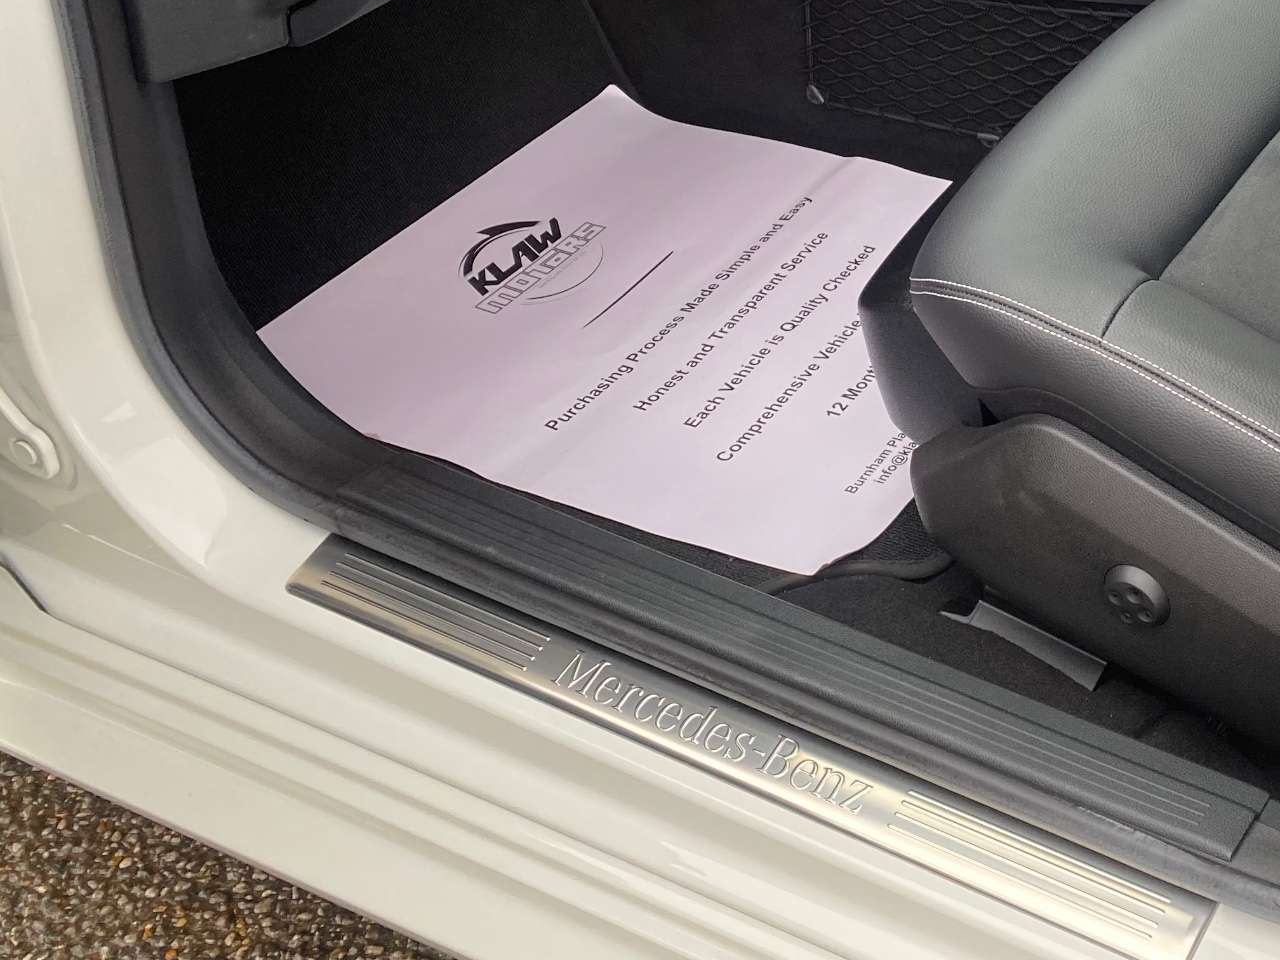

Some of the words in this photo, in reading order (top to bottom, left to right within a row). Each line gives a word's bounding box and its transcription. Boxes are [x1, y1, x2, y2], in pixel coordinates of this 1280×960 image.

[467, 217, 562, 296] KLAW
[474, 221, 607, 315] MOTORS
[544, 363, 634, 431] Purchasing
[625, 315, 685, 363] Process
[679, 282, 720, 313] Made
[715, 244, 761, 281] Simple
[758, 223, 784, 243] and
[778, 196, 813, 221] Easy
[632, 368, 690, 412] Honest
[686, 343, 715, 368] and
[708, 272, 788, 340] Transparent
[780, 231, 828, 272] Service
[682, 396, 726, 428] Each
[717, 346, 772, 391] Vehicle
[764, 334, 785, 346] is
[780, 293, 829, 332] Quality
[822, 244, 876, 292] Checked
[716, 362, 820, 462] Comprehensive
[813, 319, 862, 360] Vehicle
[826, 401, 849, 417] 12
[843, 448, 893, 495] Burnham
[886, 432, 906, 448] Pla
[873, 441, 917, 484] info@kla
[550, 648, 875, 816] Mercedes-Benz
